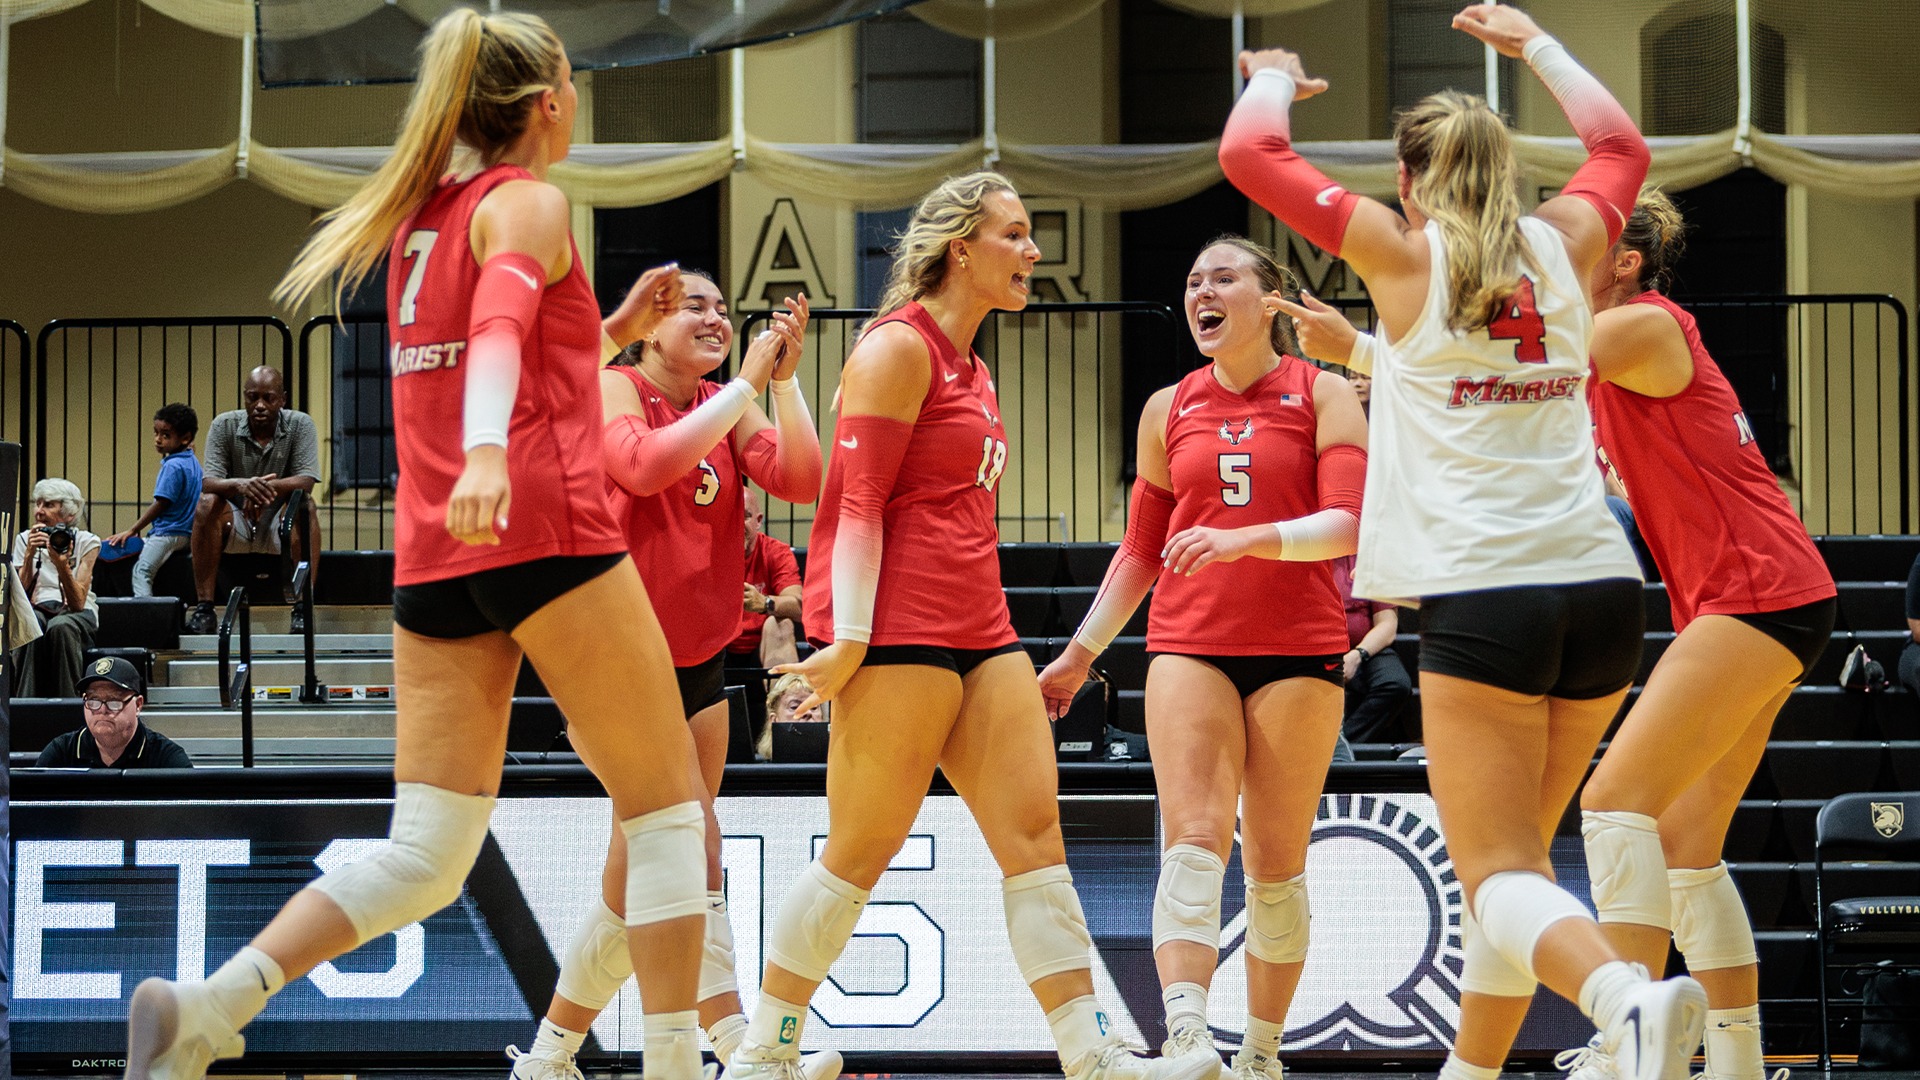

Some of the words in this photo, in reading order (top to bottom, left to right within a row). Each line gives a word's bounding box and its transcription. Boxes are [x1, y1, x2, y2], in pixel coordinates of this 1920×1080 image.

[399, 229, 439, 326] 7
[1487, 273, 1548, 364] 4
[1447, 374, 1582, 409] MARIST
[694, 458, 720, 506] 3
[975, 435, 1007, 493] 18
[1218, 453, 1251, 507] 5
[722, 834, 945, 1028] 15
[72, 1060, 126, 1068] DAKTRO
